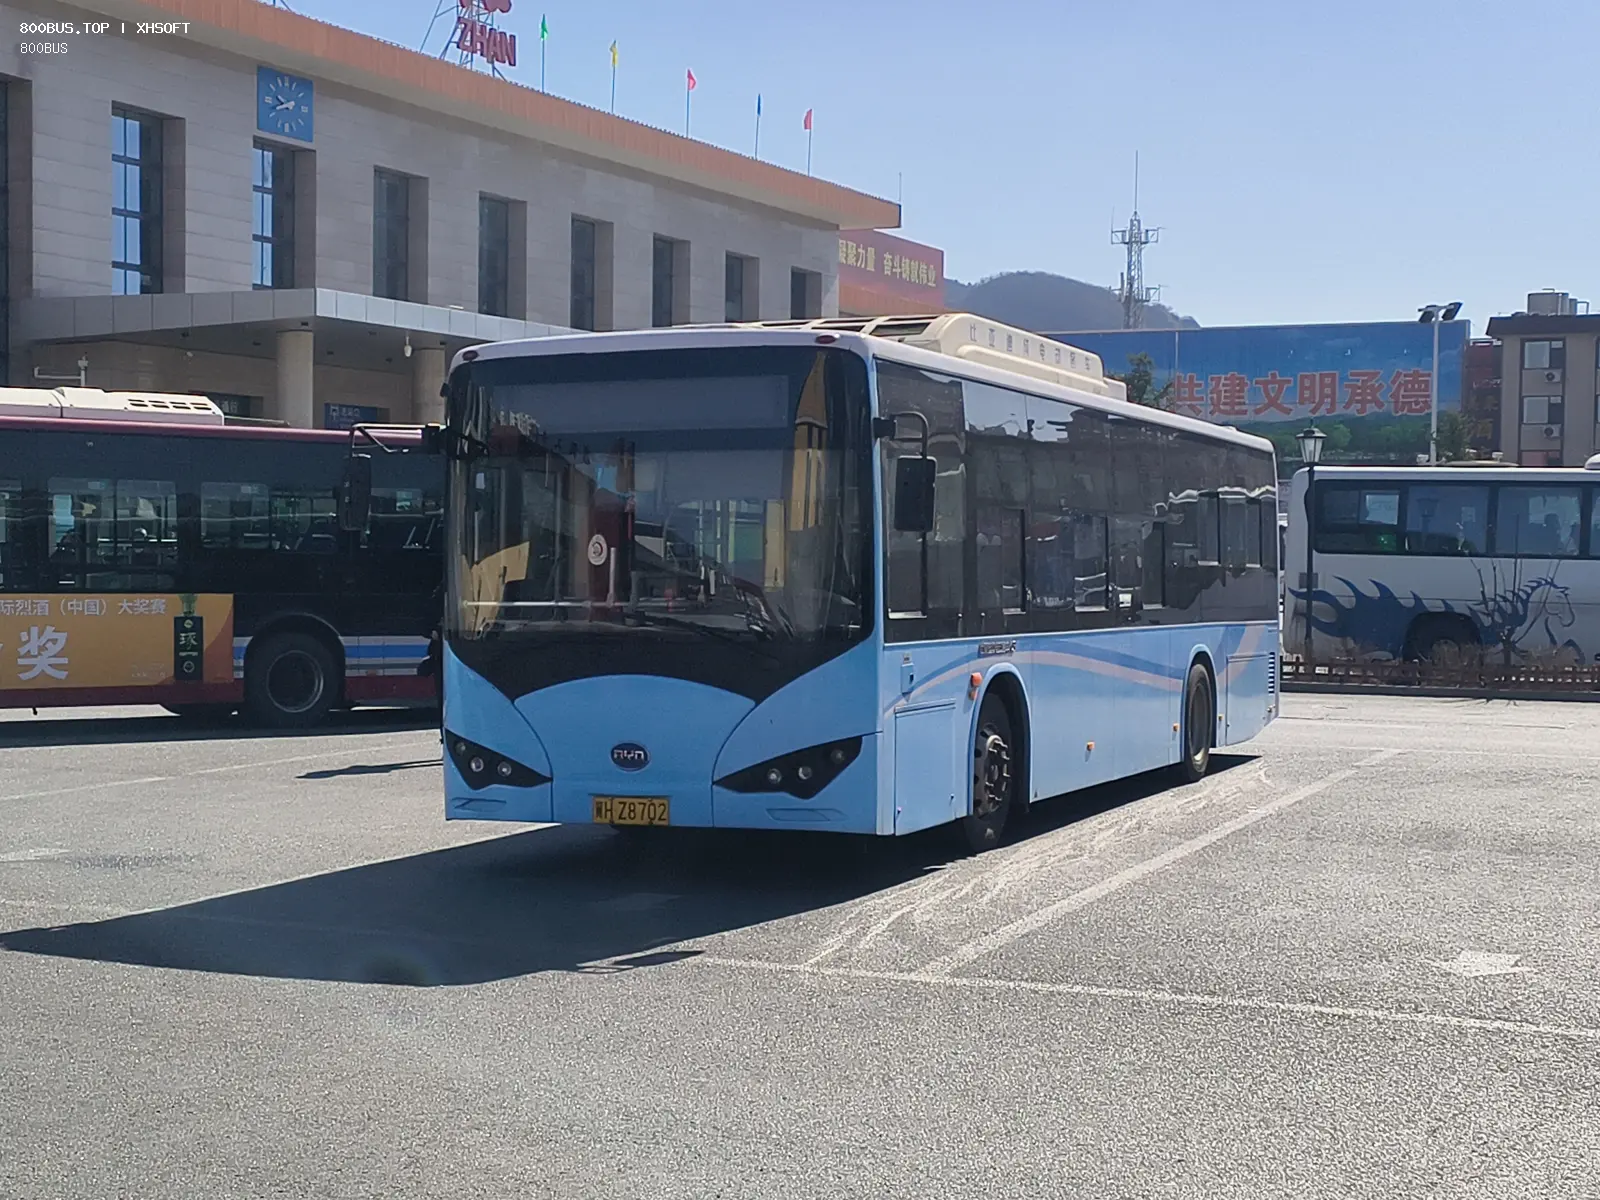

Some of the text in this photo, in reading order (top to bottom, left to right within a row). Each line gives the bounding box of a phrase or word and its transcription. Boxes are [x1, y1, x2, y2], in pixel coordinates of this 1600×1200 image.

[457, 16, 516, 66] ZHAN
[1170, 369, 1433, 417] 共建文明承德
[0, 625, 69, 681] 奖
